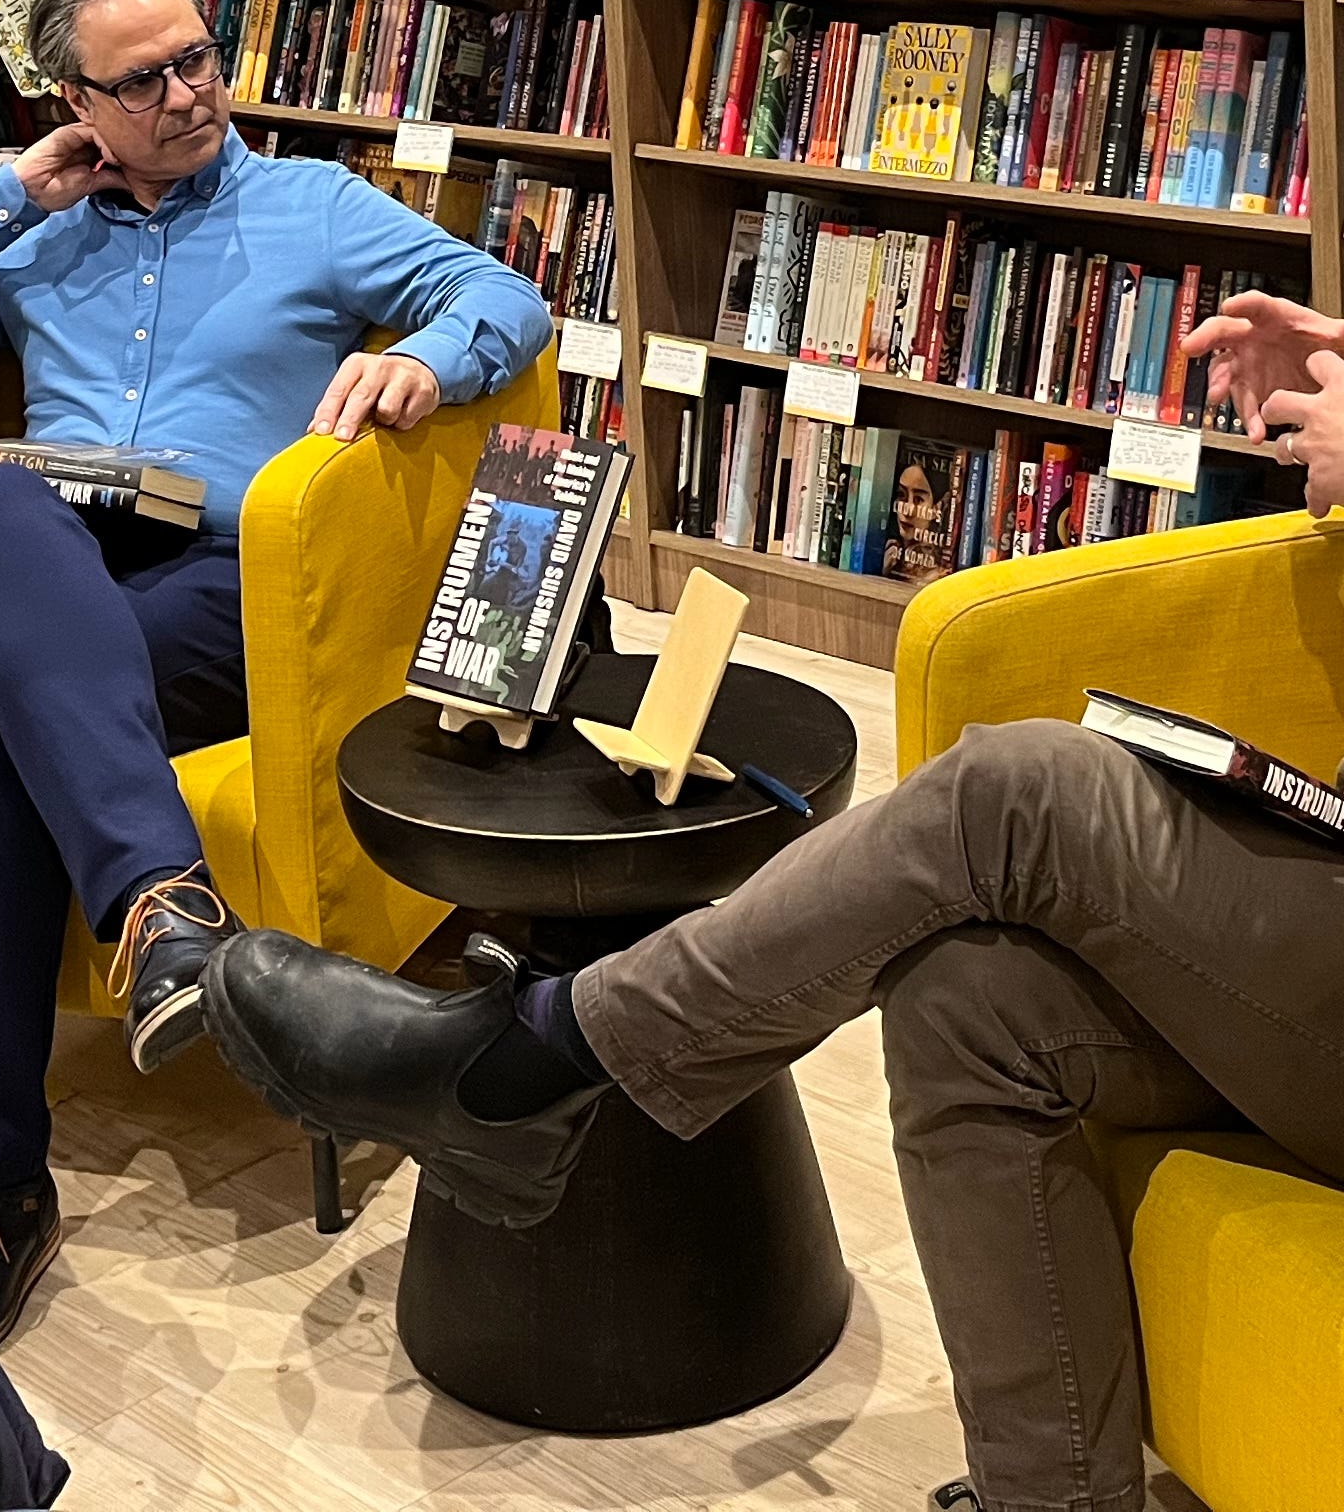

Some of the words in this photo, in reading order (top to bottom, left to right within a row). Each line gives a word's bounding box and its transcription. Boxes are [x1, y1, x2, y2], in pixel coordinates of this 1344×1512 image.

[903, 25, 959, 48] SALLY
[893, 48, 965, 74] ROONEY
[878, 156, 947, 175] INTERMEZZO
[900, 249, 914, 290] IDAHO
[59, 482, 93, 505] WAR
[550, 509, 582, 563] DAVID
[415, 488, 497, 673] INSTRUMENT
[457, 597, 490, 637] OF
[521, 565, 564, 653] SUISMAN
[444, 638, 501, 687] WAR
